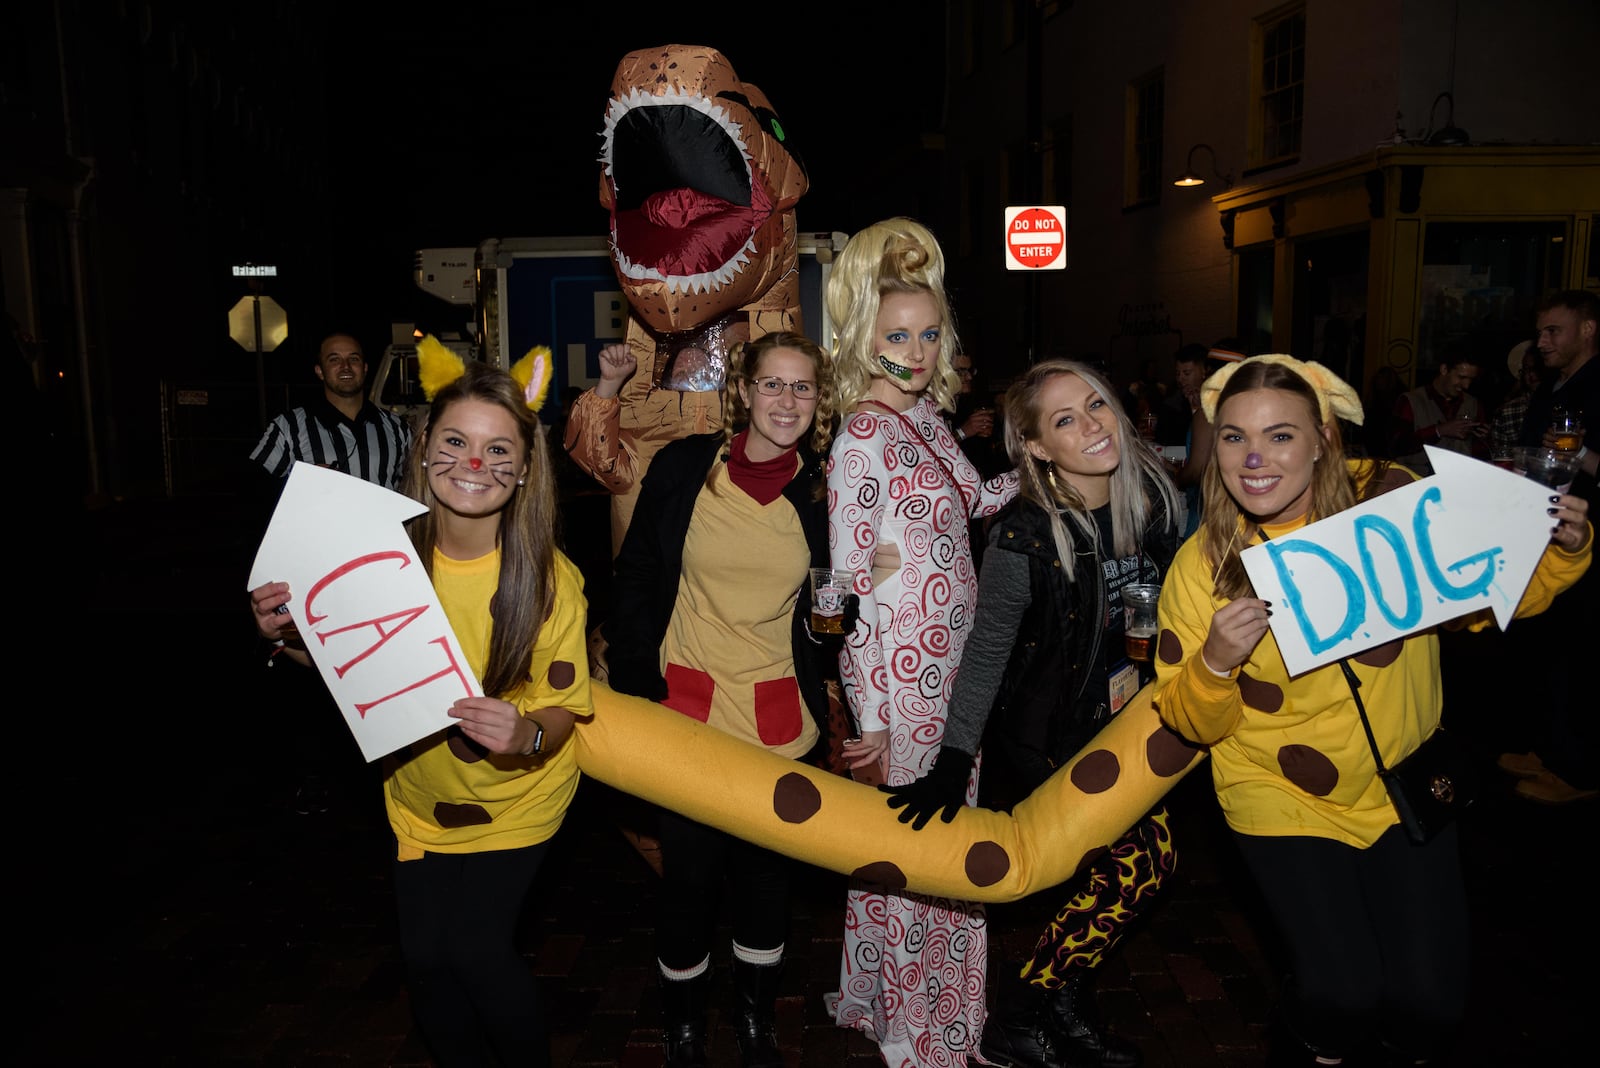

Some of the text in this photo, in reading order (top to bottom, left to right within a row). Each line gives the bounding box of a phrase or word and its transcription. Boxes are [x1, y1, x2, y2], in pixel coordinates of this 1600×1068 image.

[1014, 219, 1056, 230] DO NOT
[1019, 246, 1053, 257] ENTER
[1265, 486, 1503, 657] DOG
[305, 550, 474, 720] CAT
